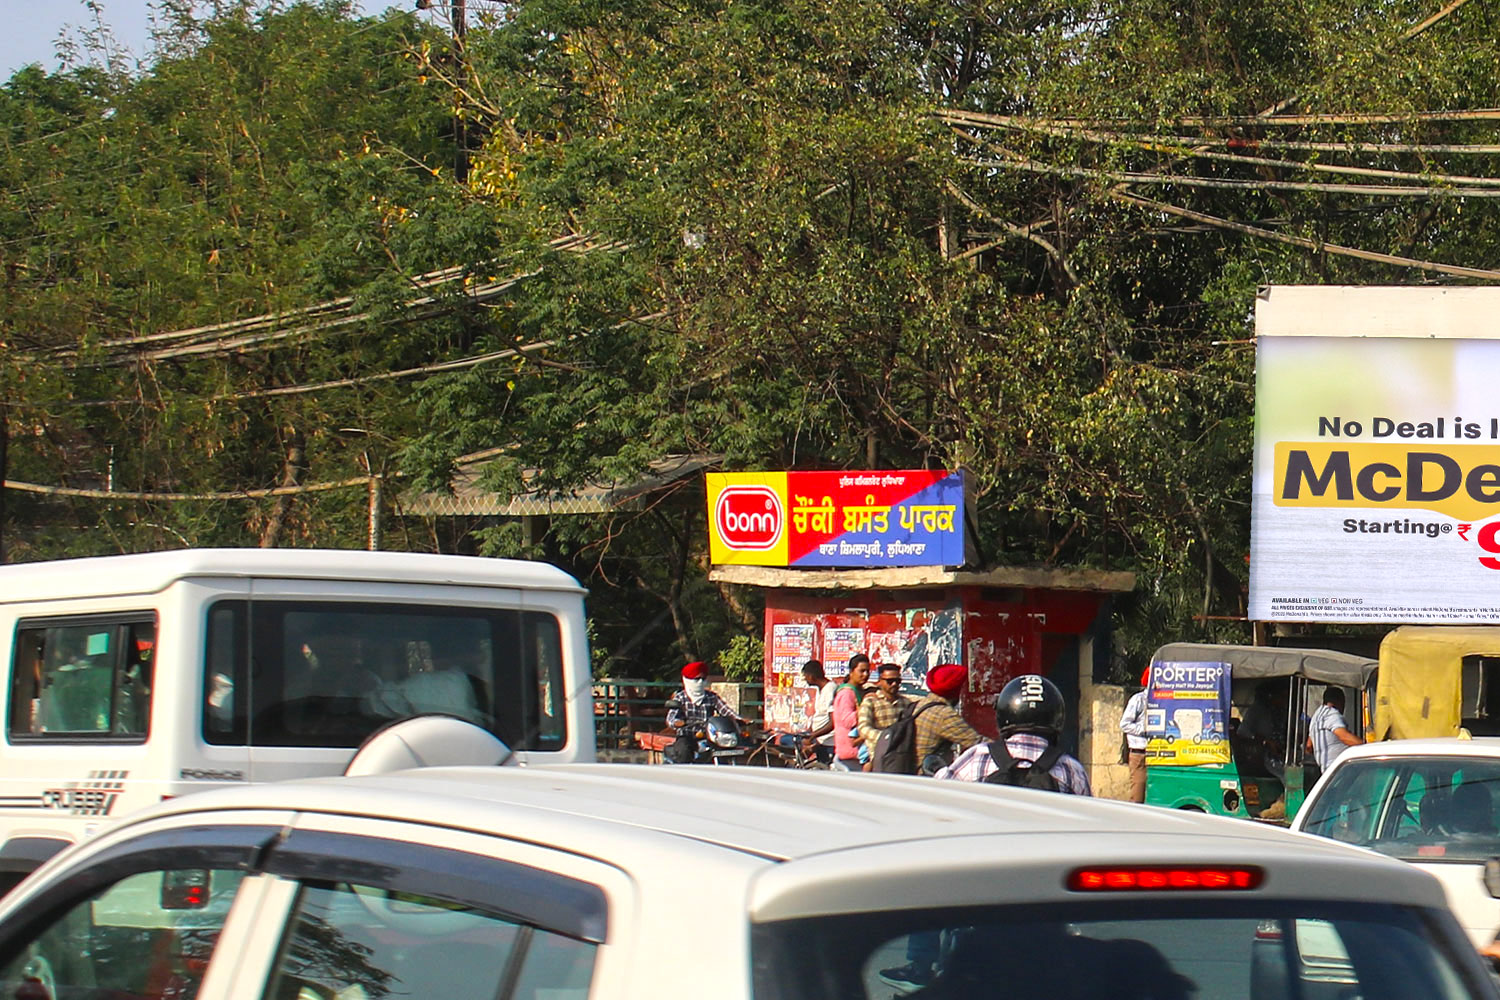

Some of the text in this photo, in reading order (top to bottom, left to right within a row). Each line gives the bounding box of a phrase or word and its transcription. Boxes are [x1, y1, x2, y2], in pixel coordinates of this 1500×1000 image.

[1318, 417, 1362, 438] No
[1372, 417, 1444, 439] Deal
[1454, 417, 1481, 439] is
[725, 500, 775, 532] bonn
[793, 494, 956, 534] ਚੌਂਕੀ ਬਸੰਤ ਪਾਰਕ
[1154, 667, 1216, 682] PORTER
[42, 791, 107, 810] CRUISER
